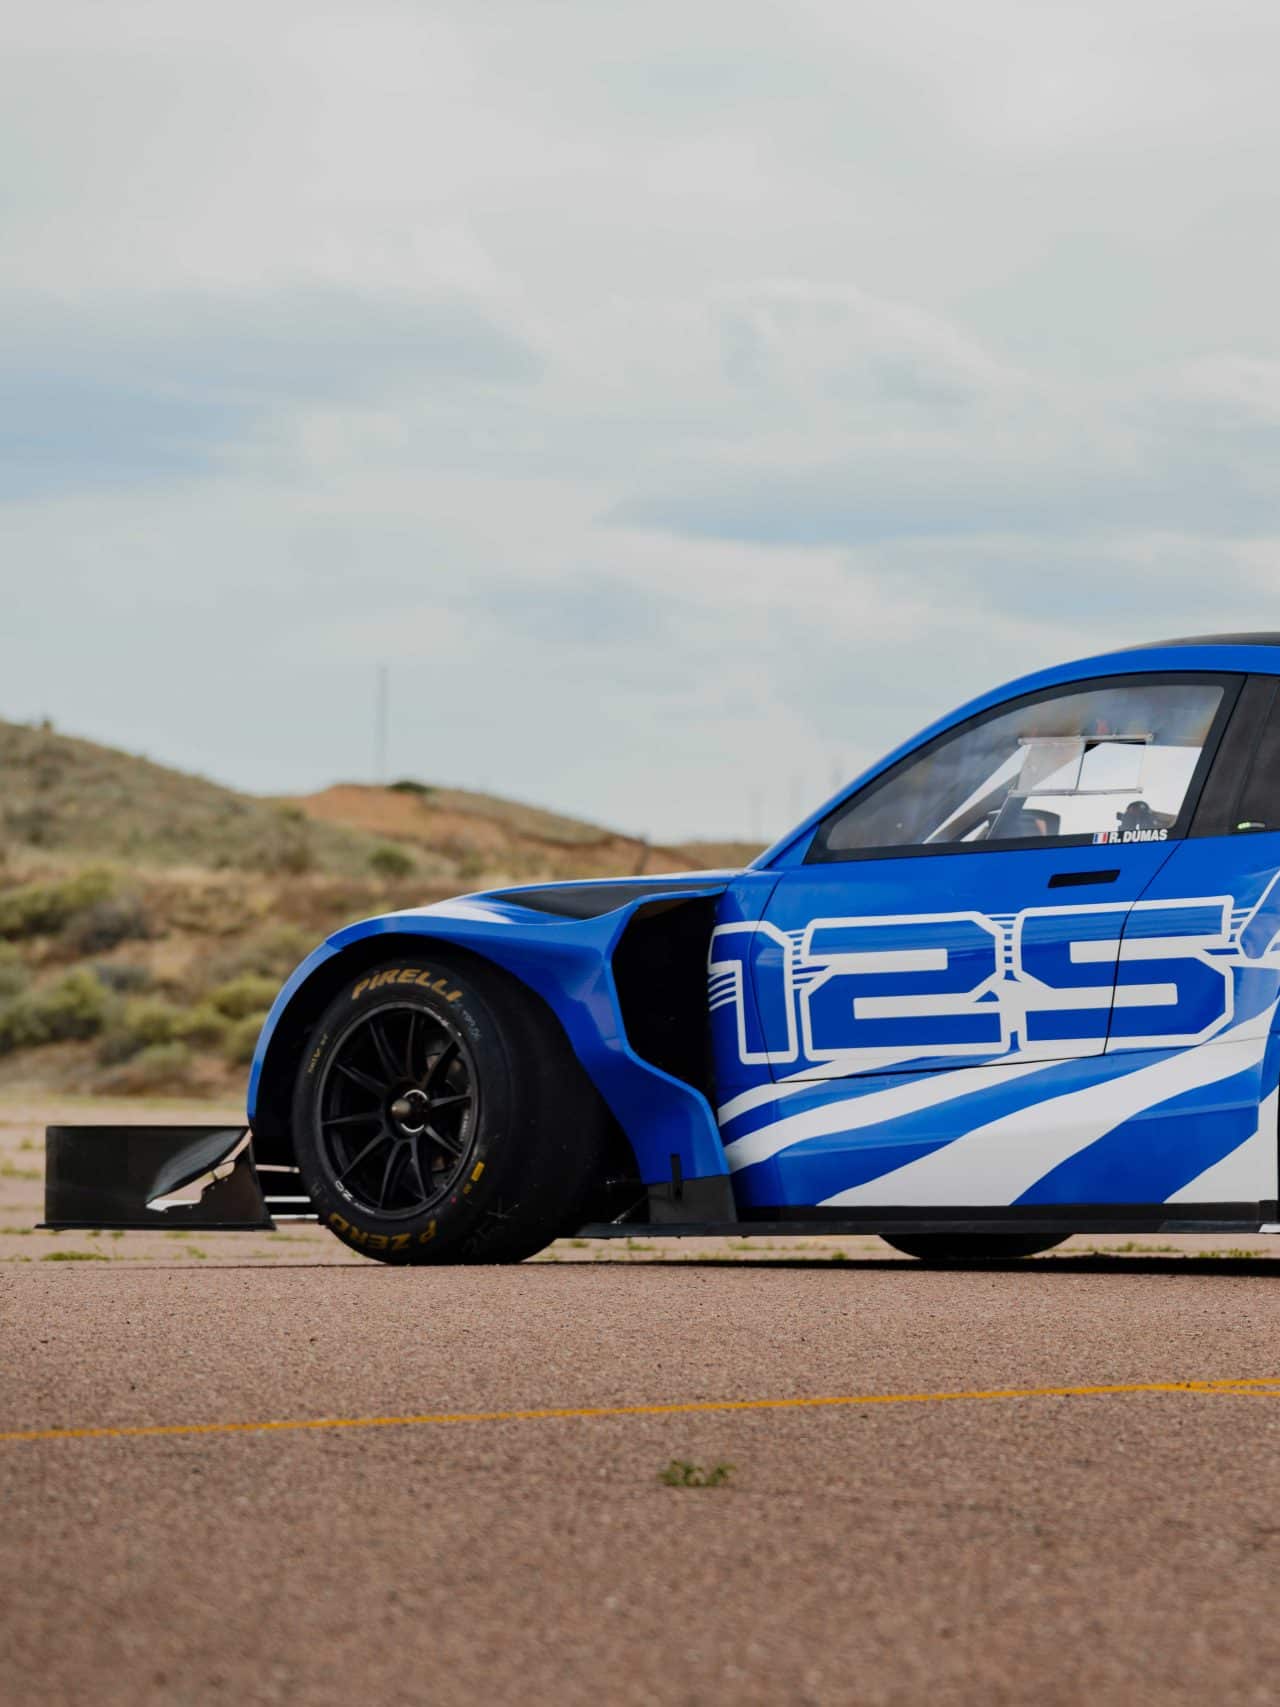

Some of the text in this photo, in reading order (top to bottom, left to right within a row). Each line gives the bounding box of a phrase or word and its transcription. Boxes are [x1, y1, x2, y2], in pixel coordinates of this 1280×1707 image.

[1108, 828, 1168, 844] R. DUMAS
[351, 967, 464, 1003] PIRELLI
[708, 895, 1234, 1065] 125
